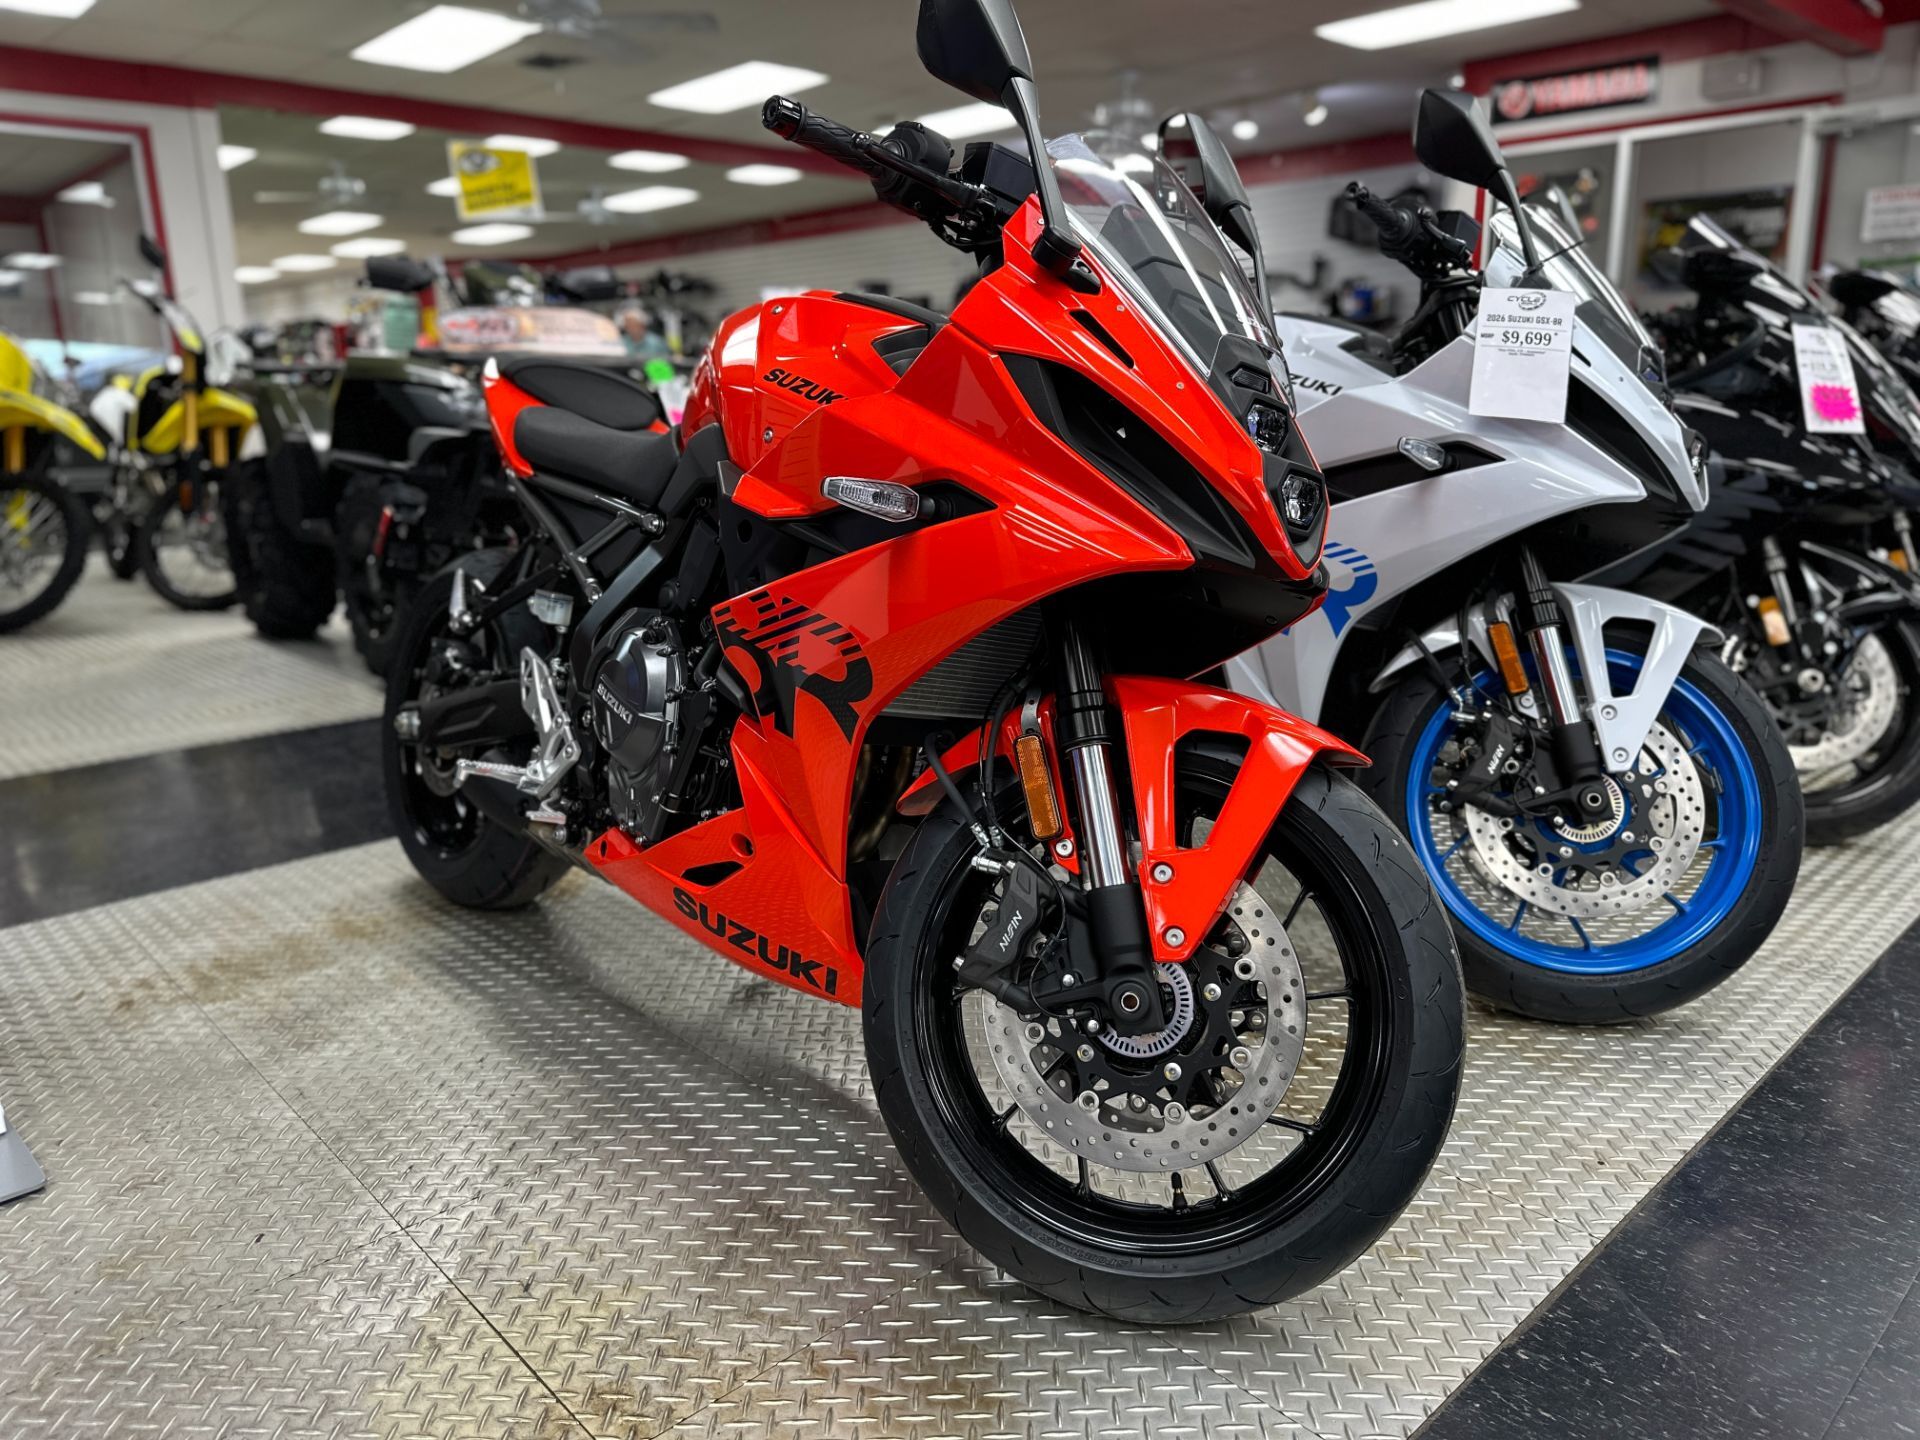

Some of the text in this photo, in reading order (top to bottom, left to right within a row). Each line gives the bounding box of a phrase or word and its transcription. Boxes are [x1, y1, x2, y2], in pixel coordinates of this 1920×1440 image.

[1486, 313, 1563, 326] 2026 SUZUKI GSX-8R
[1501, 330, 1552, 347] $9,699
[763, 368, 849, 405] SUZUK
[1289, 373, 1344, 396] ZUKI
[597, 683, 633, 725] SUZUKI
[673, 887, 838, 996] SUZUKI
